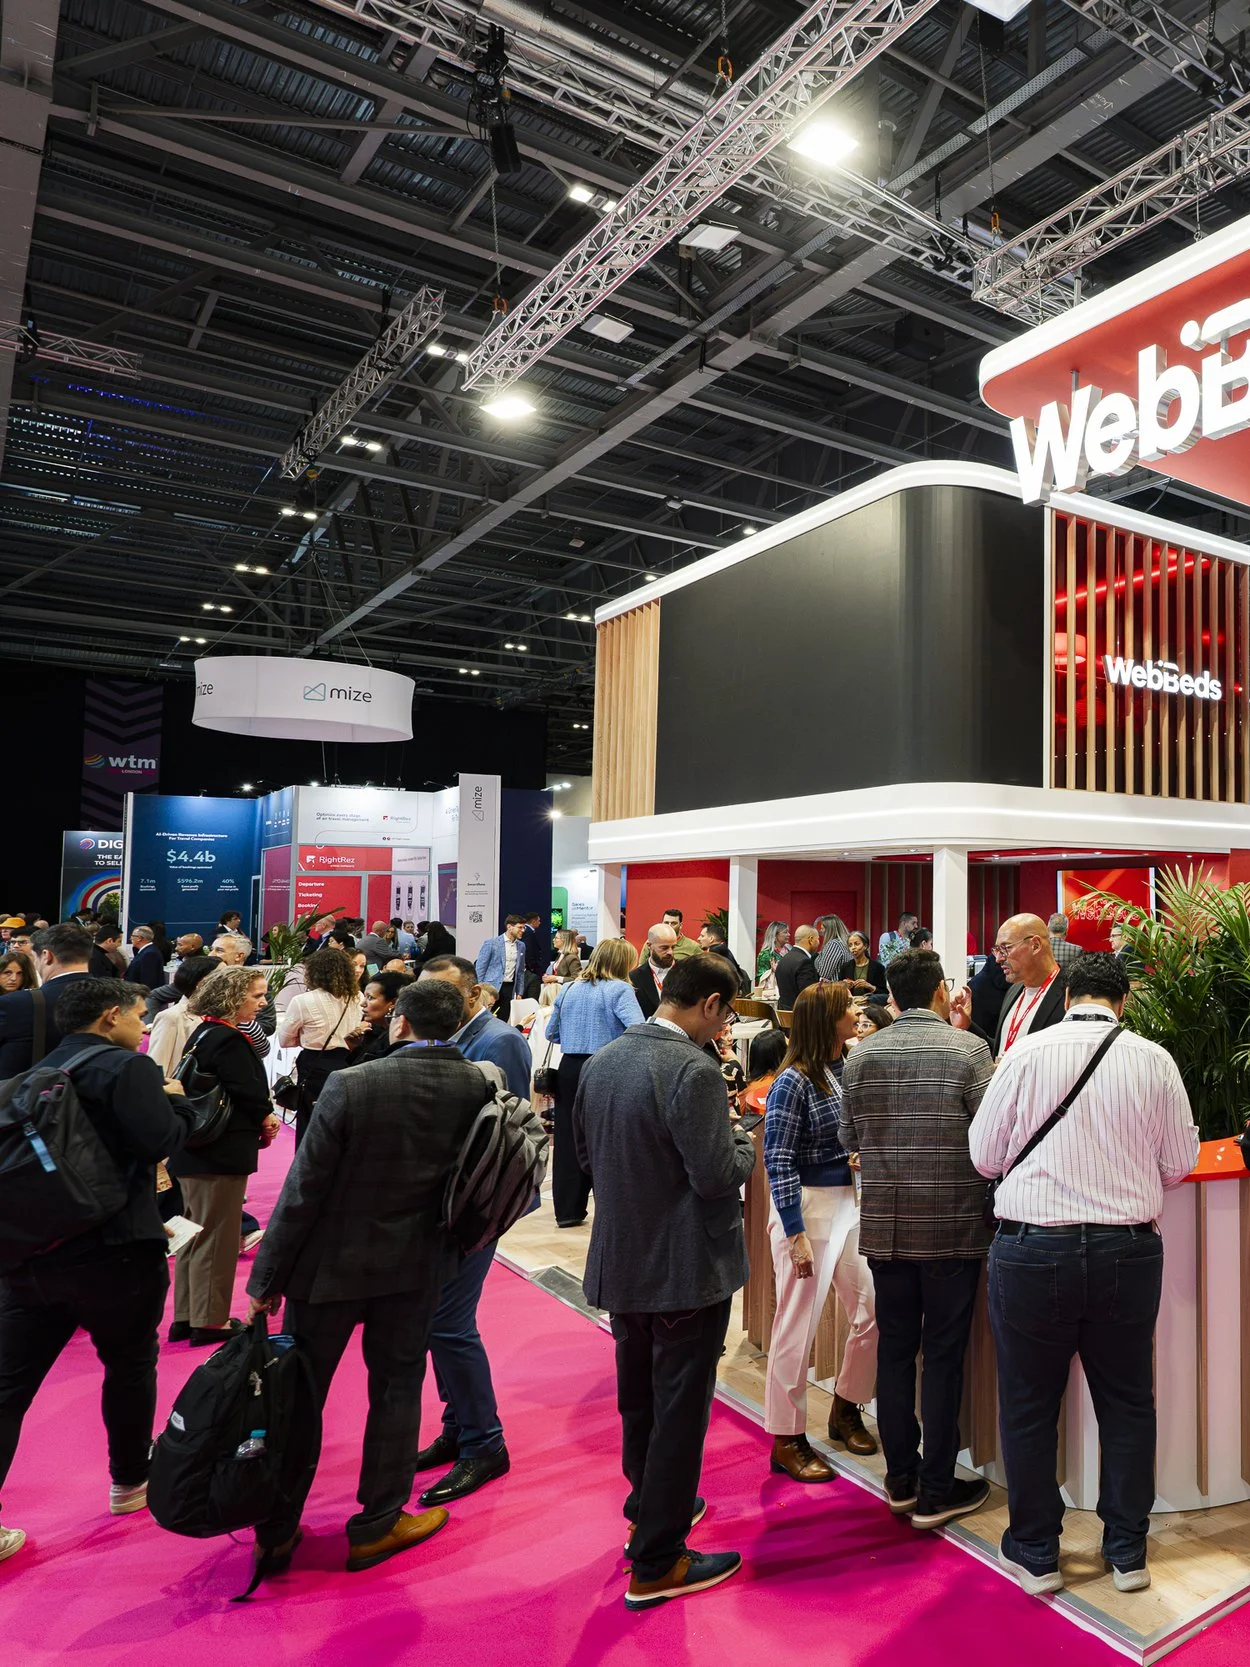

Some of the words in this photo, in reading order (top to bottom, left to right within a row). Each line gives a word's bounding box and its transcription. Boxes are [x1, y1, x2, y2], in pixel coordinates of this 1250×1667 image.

[1101, 654, 1222, 700] WebBeds
[330, 686, 372, 703] mize
[108, 754, 157, 769] wtm
[472, 785, 483, 809] mize
[166, 849, 216, 864] $4.4b
[319, 856, 355, 865] RightRez
